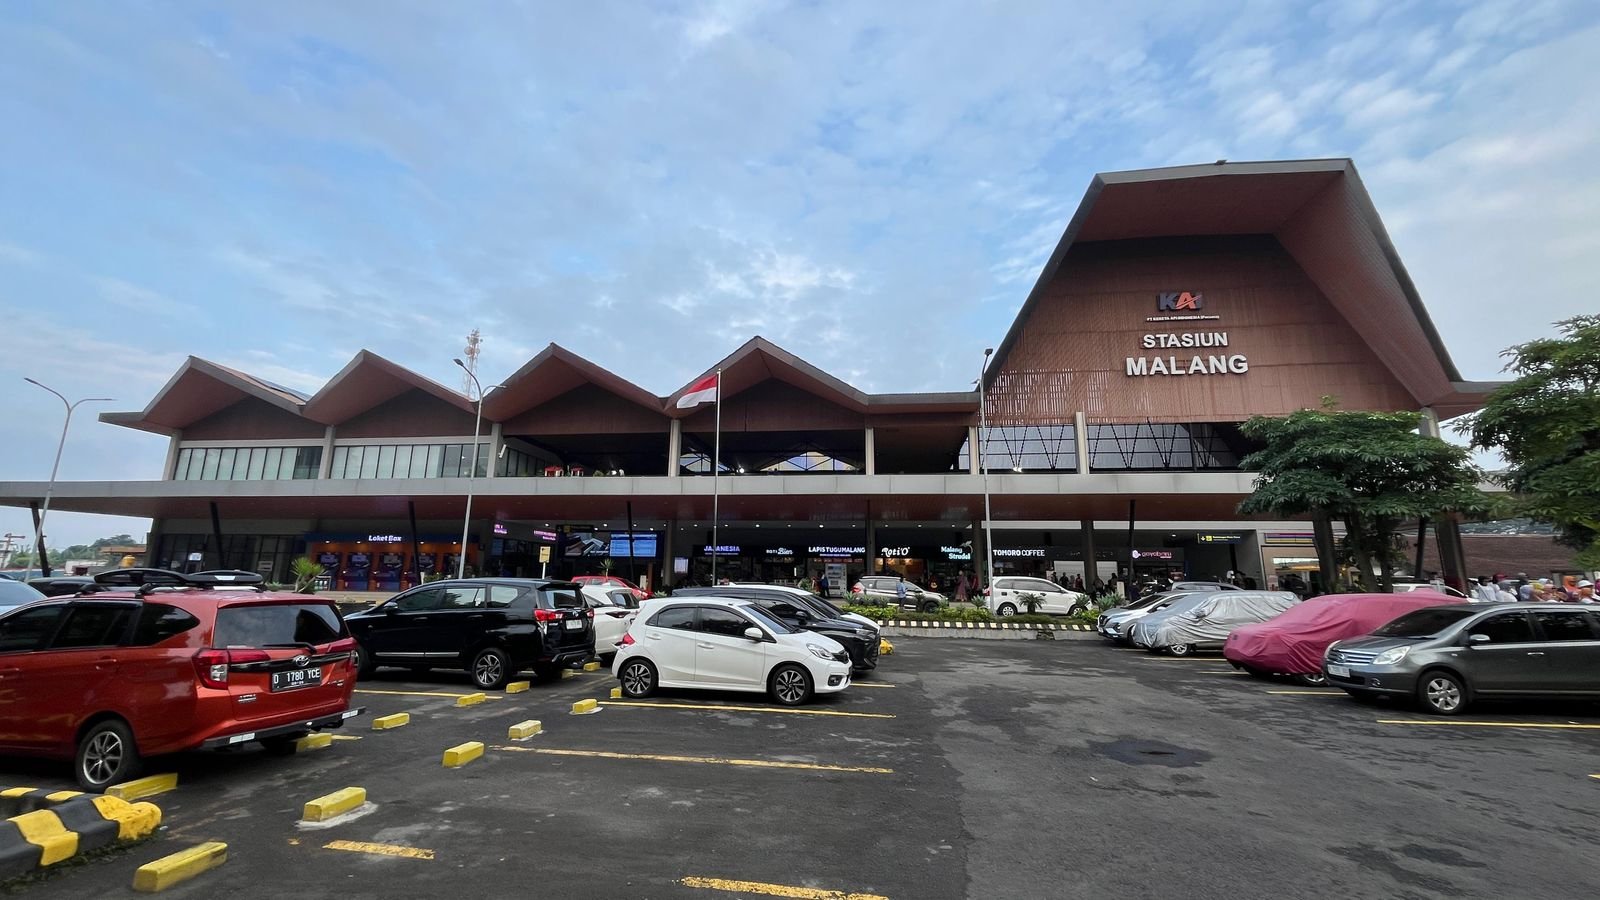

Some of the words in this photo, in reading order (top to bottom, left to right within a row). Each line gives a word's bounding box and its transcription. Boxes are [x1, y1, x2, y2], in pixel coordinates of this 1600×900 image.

[1159, 292, 1202, 310] KAI
[1143, 332, 1228, 348] STASIUN
[1126, 354, 1249, 376] MALANG
[368, 534, 388, 542] Loket
[388, 534, 402, 542] Box
[940, 546, 962, 554] Malang
[948, 552, 971, 560] Strudel
[273, 674, 279, 684] D
[287, 671, 304, 683] 1780
[307, 668, 320, 679] YCE
